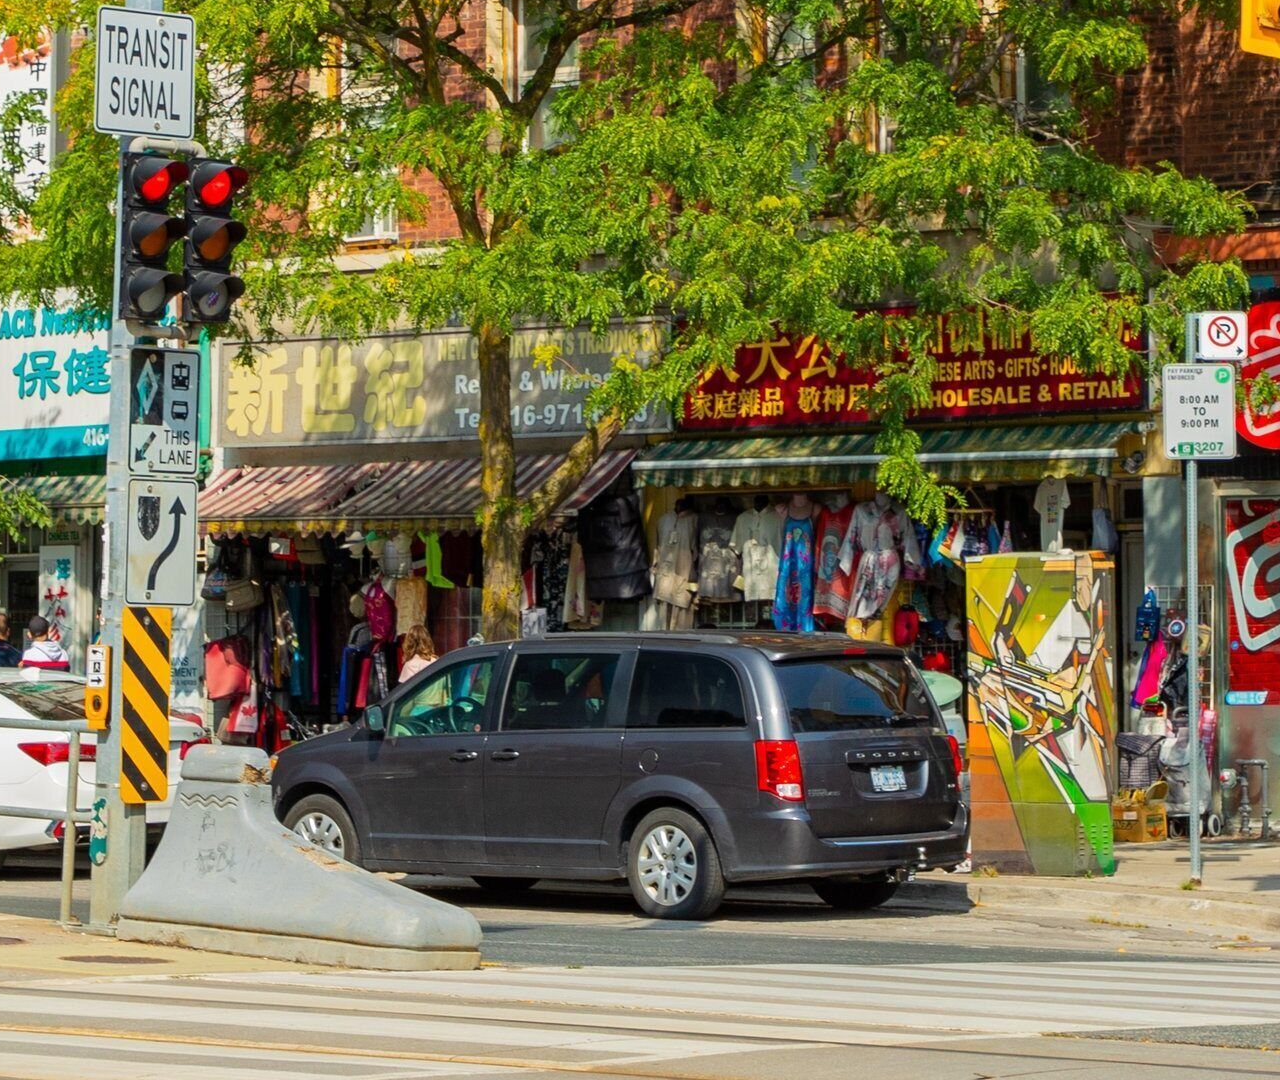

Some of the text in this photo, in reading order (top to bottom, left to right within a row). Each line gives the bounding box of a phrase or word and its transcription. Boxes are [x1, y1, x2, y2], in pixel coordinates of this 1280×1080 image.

[104, 24, 189, 72] TRANSIT
[108, 76, 182, 122] SIGNAL
[438, 337, 471, 362] NEW
[577, 327, 639, 355] TRADING
[12, 344, 112, 401] 保健
[963, 359, 995, 381] ARTS
[1005, 356, 1041, 379] GIFTS
[226, 340, 428, 437] 新世紀
[520, 370, 534, 392] &
[1037, 384, 1053, 403] &
[1058, 380, 1131, 402] RETAIL
[1179, 395, 1220, 405] 8:00 AM
[1193, 407, 1206, 416] TO
[1180, 419, 1220, 429] 9:00 PM
[163, 429, 191, 446] THIS
[159, 449, 193, 466] LANE
